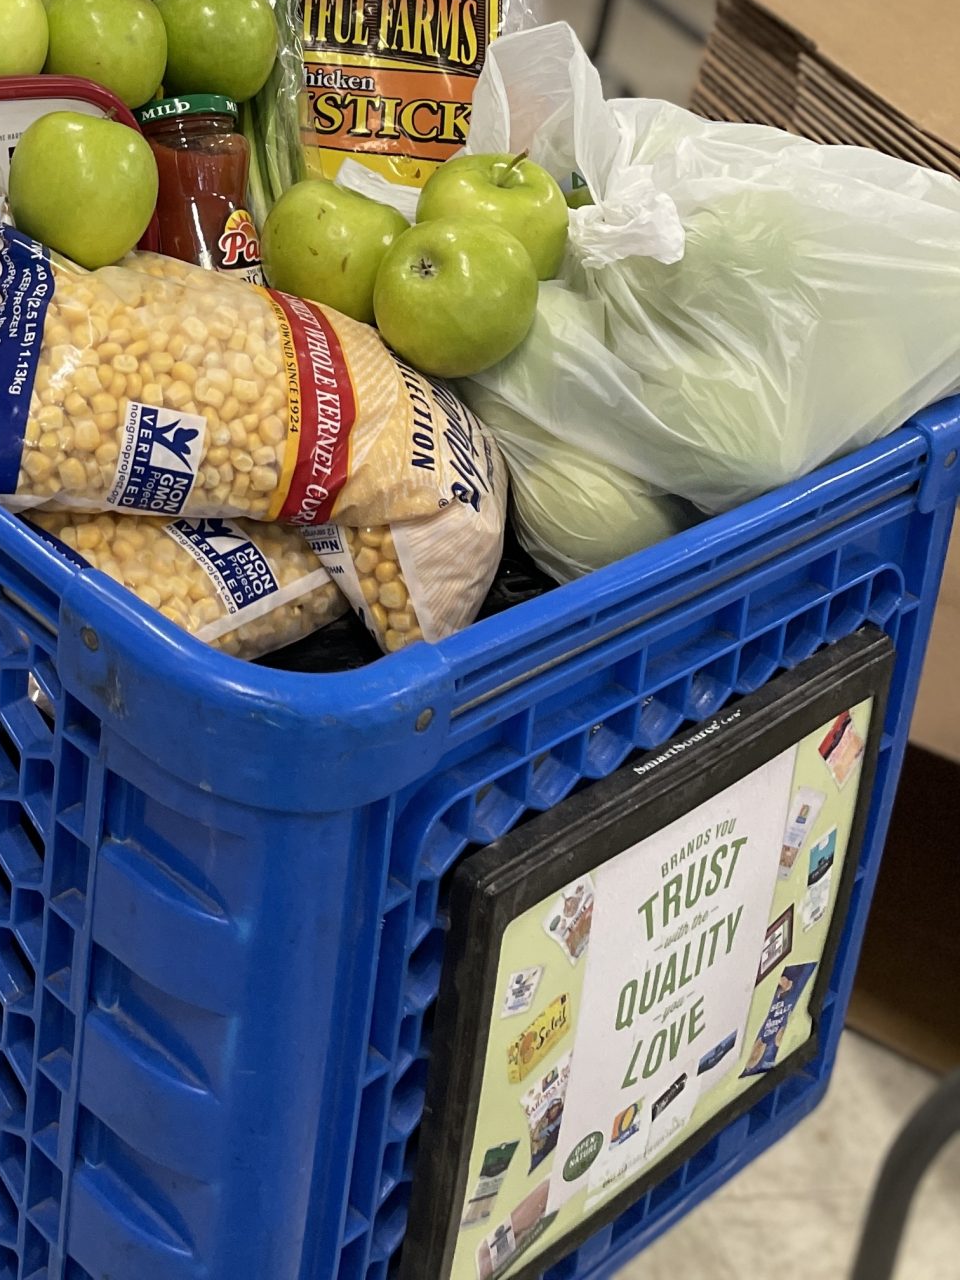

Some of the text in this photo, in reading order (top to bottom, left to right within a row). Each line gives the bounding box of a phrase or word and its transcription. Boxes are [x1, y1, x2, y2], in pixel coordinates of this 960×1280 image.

[304, 67, 376, 91] hicken
[142, 99, 191, 120] MILD
[311, 92, 473, 144] STICK
[219, 230, 261, 266] Pa
[32, 284, 48, 297] OZ
[36, 264, 48, 280] 40
[9, 290, 25, 338] FROZEN
[27, 297, 42, 319] (2.5
[20, 323, 37, 347] LB)
[280, 323, 294, 359] OWNED
[9, 350, 31, 395] 1.13kg
[303, 326, 338, 388] WHOLE
[287, 362, 299, 395] SINCE
[290, 399, 299, 433] 1924
[311, 388, 341, 476] KERNEL
[106, 404, 139, 505] nongmoproject.org
[122, 414, 155, 505] VERIFIED
[139, 470, 161, 507] Project
[150, 473, 174, 510] GMO
[163, 477, 189, 512] NON
[166, 525, 237, 615] nongmoproject.org
[180, 524, 244, 604] VERIFIED
[227, 555, 255, 599] Project
[235, 552, 263, 595] GMO
[244, 547, 273, 590] NON
[633, 720, 720, 775] SmartSource
[661, 818, 737, 878] BRANDS YOU
[637, 836, 748, 941] TRUST
[664, 910, 709, 949] with the
[615, 904, 744, 1031] QUALITY
[661, 996, 685, 1024] you
[621, 995, 706, 1090] LOVE
[569, 1143, 598, 1169] NATURE
[574, 1134, 596, 1156] OPEN
